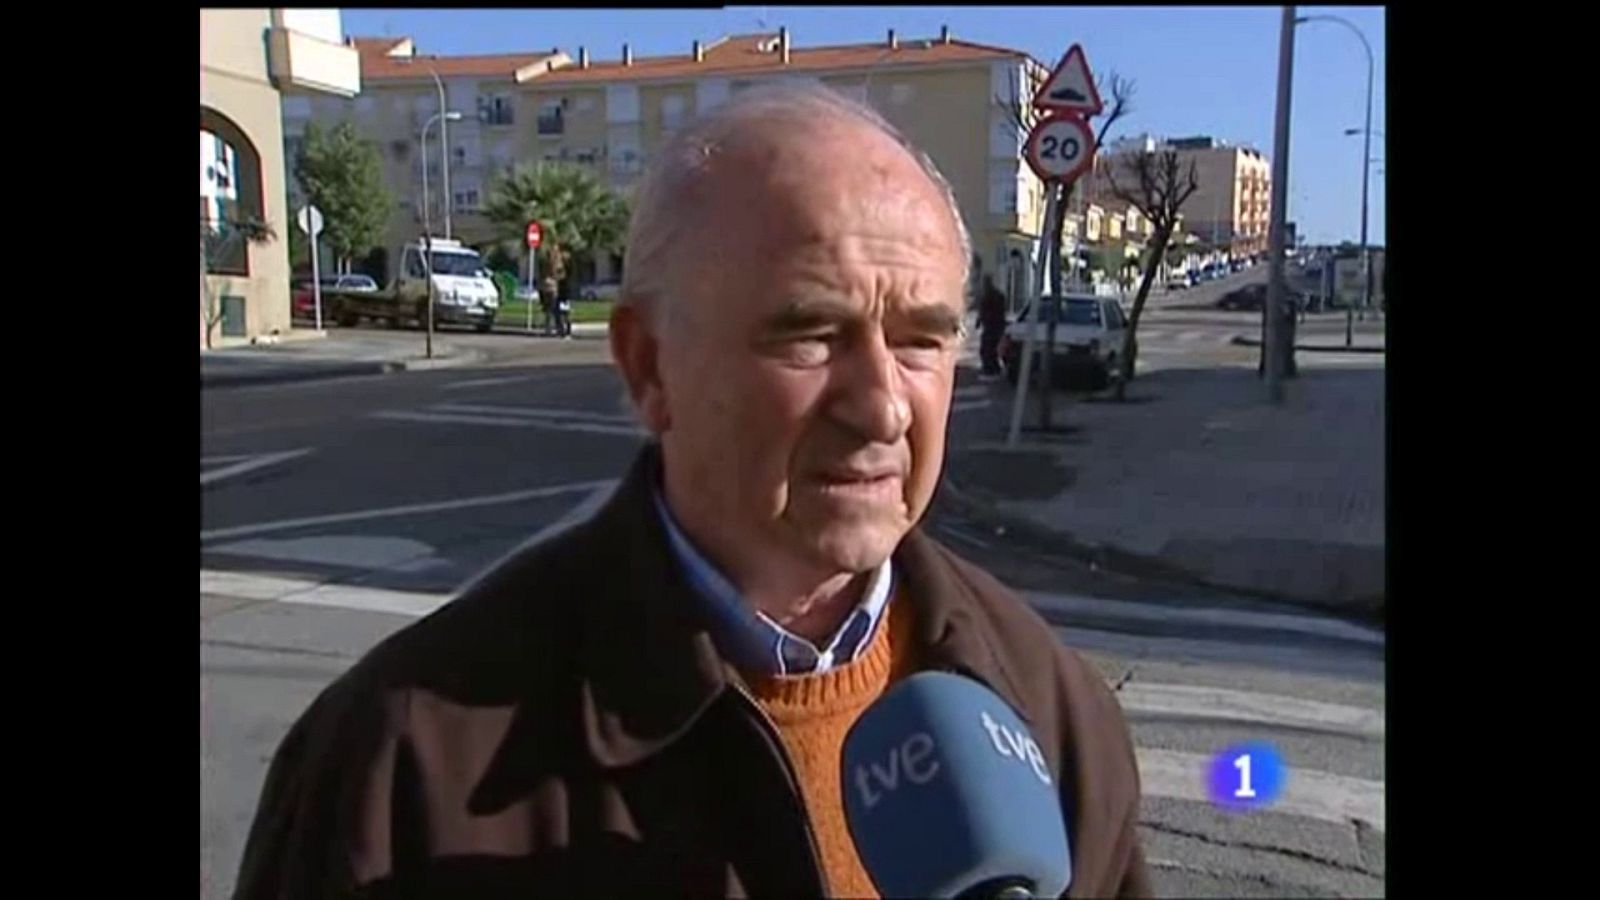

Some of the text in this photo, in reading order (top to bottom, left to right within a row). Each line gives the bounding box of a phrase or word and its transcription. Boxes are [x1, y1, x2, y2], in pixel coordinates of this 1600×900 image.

[1040, 135, 1080, 161] 20
[854, 732, 940, 808] tve
[980, 710, 1052, 785] tve
